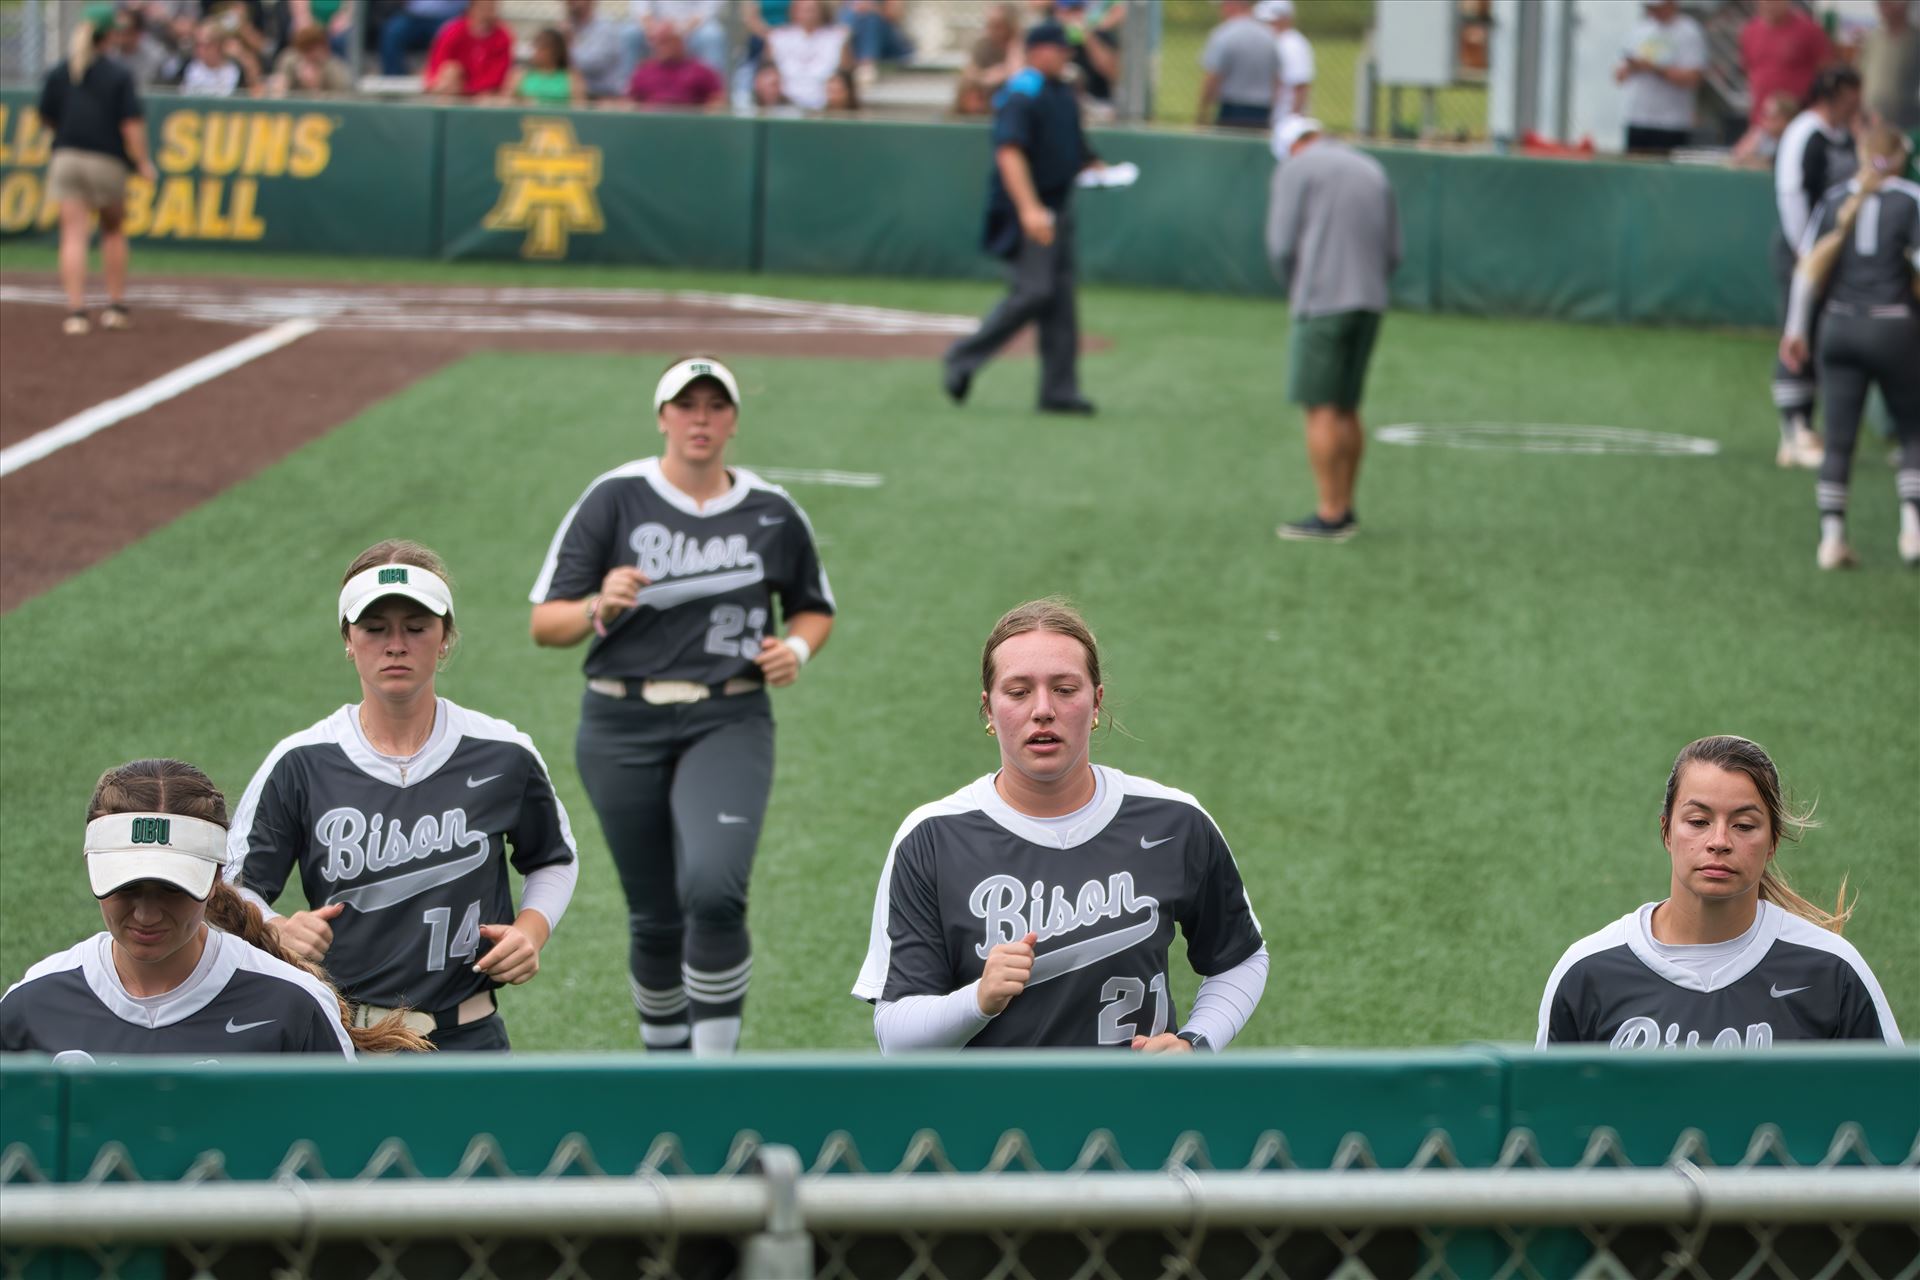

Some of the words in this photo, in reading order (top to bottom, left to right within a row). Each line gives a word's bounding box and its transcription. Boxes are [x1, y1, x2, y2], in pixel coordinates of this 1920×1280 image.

[158, 109, 332, 178] SUNS
[0, 171, 265, 239] OBALL
[630, 522, 763, 580] Bison
[132, 817, 170, 845] OBU
[315, 807, 488, 884] Bison
[423, 899, 481, 972] 14
[969, 871, 1158, 960] Bison
[1098, 972, 1168, 1044] 21
